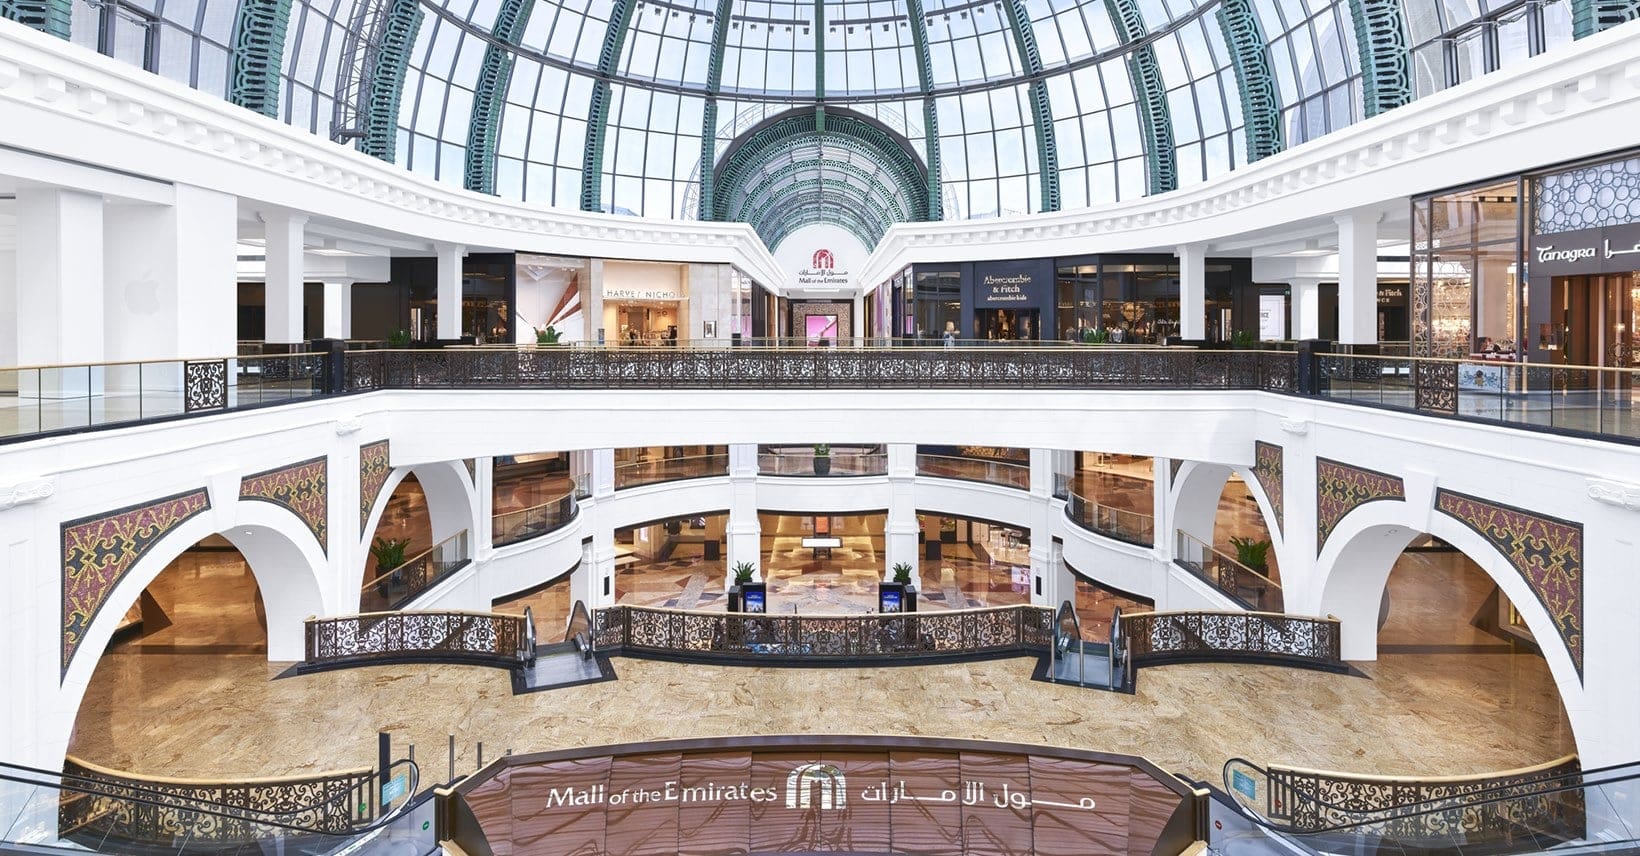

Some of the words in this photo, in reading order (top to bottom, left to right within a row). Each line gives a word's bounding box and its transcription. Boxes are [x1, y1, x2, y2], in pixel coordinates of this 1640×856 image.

[1536, 245, 1596, 262] Tanagra
[984, 274, 1031, 284] Abercrombie
[1001, 284, 1020, 293] Fitch
[546, 784, 604, 808] Mall
[609, 789, 630, 805] of
[631, 788, 661, 802] the
[664, 781, 777, 802] Emirates
[992, 783, 1096, 810] مول
